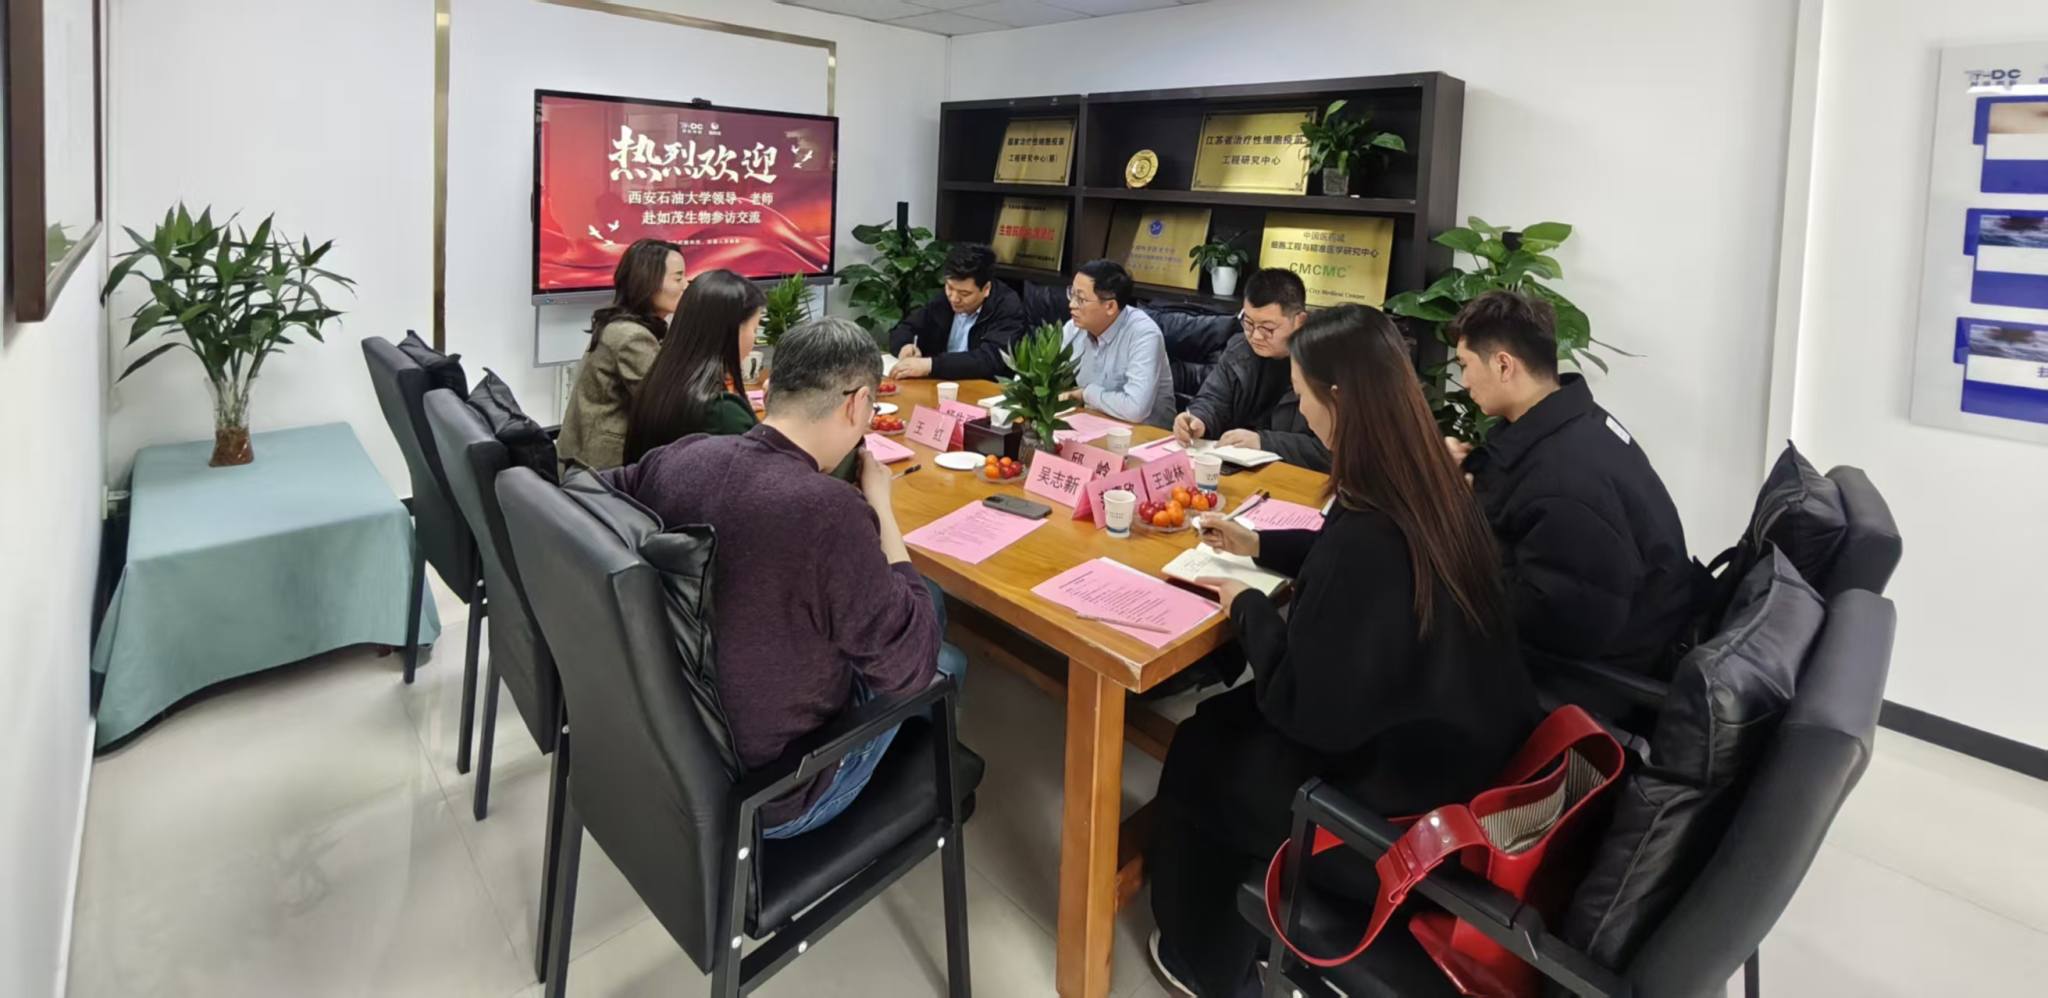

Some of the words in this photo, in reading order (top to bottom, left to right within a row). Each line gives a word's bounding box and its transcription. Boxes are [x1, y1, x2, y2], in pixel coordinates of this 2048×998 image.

[608, 125, 778, 184] 热烈欢迎
[1222, 155, 1281, 166] 工程研究中心
[628, 190, 774, 206] 西安石油大学领导、老师
[641, 210, 761, 225] 赴如茂生物参访交流
[1270, 241, 1379, 258] 细胞工程与精准医学研究中心
[1289, 262, 1347, 279] CMCMC
[1321, 289, 1344, 298] Medical
[1345, 292, 1366, 300] Center
[1037, 465, 1081, 496] 吴志新
[1152, 465, 1186, 491] 王业林
